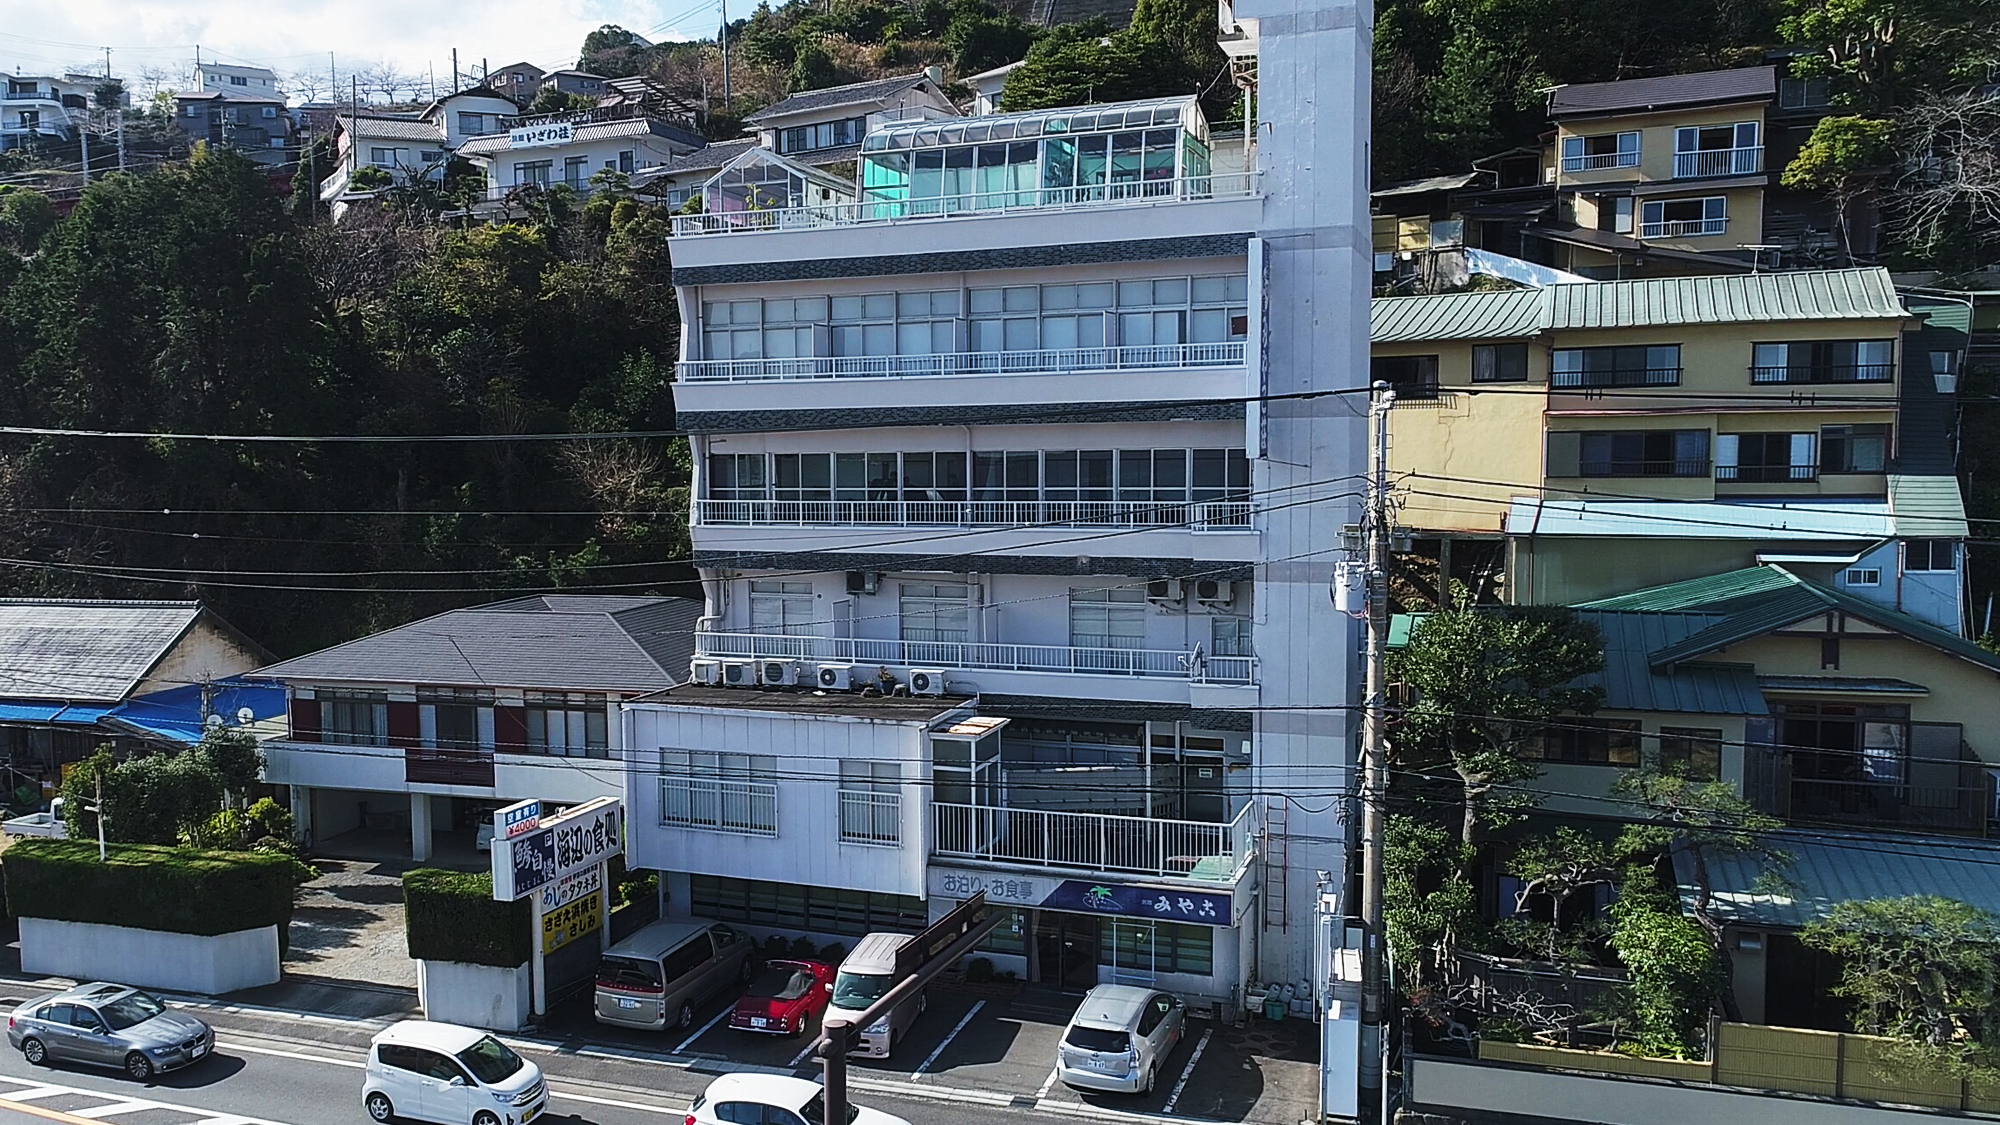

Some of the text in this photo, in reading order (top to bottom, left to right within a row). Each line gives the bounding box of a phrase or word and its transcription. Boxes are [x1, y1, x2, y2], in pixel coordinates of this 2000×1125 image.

[526, 126, 570, 143] いざわ荘
[508, 817, 536, 835] ¥4000
[557, 810, 618, 870] 海辺の食処
[543, 872, 599, 908] あじのタタキ丼
[944, 874, 1033, 899] お泊り・お食事
[569, 915, 596, 937] さしみ
